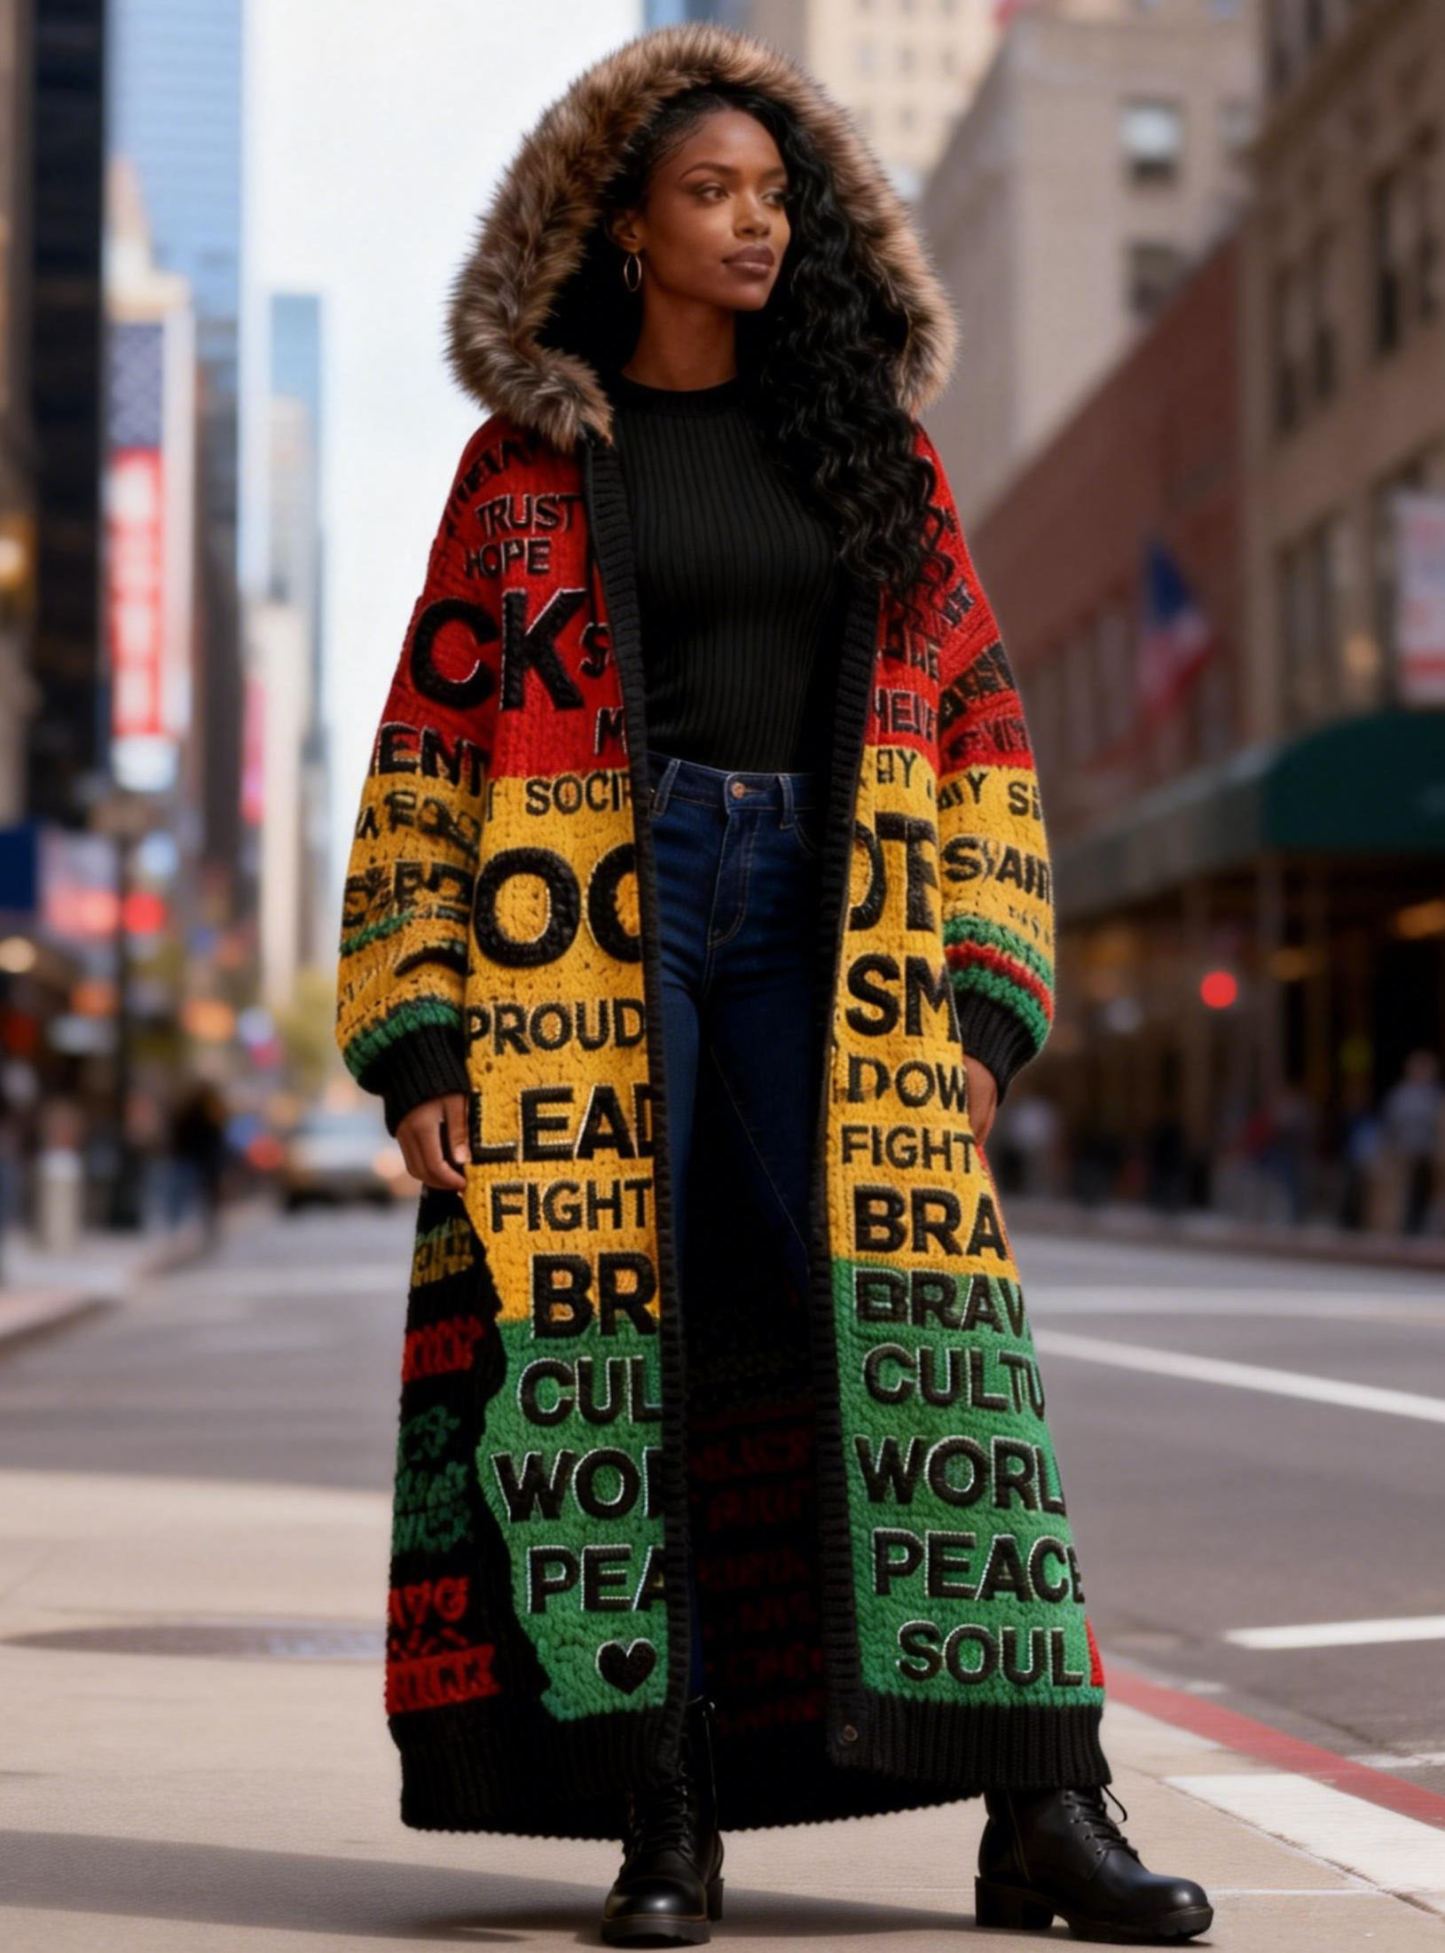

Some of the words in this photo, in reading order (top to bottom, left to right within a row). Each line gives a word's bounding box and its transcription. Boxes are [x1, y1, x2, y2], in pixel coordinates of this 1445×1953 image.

[475, 492, 581, 537] TRUST
[464, 537, 551, 580] HOPE
[410, 586, 588, 712] CK
[465, 996, 650, 1054] PROUD
[844, 953, 962, 1042] SM
[840, 1122, 975, 1174] FIGHT
[490, 1178, 655, 1233] FIGHT
[853, 1183, 1008, 1262] BRA
[530, 1251, 658, 1341] BR
[517, 1355, 664, 1426] CUL
[863, 1342, 1046, 1422] CULTU
[854, 1434, 1066, 1516] WORL
[895, 1618, 1084, 1688] SOUL
